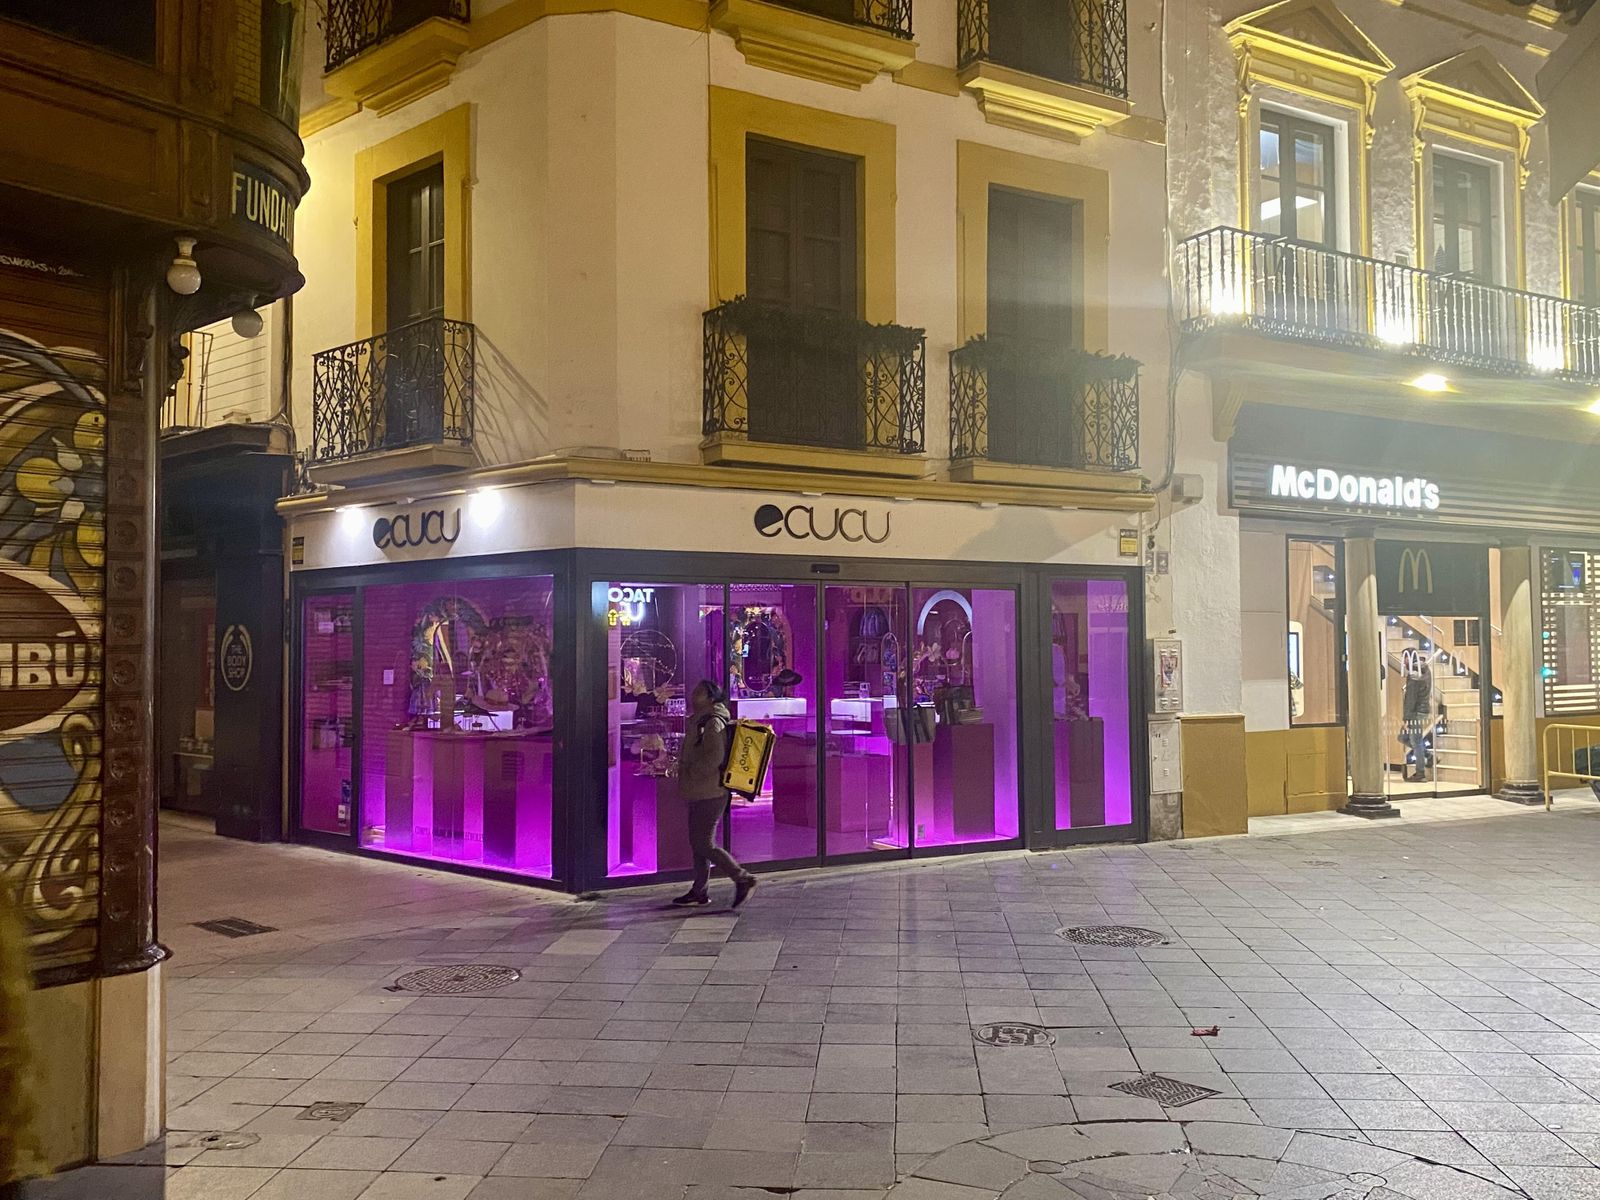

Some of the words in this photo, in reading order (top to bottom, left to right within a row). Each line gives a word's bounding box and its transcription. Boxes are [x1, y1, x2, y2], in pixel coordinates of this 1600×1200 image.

[1271, 464, 1441, 510] McDonald's
[373, 507, 461, 549] ecucu
[754, 504, 891, 543] ecucu
[227, 655, 247, 666] BODY
